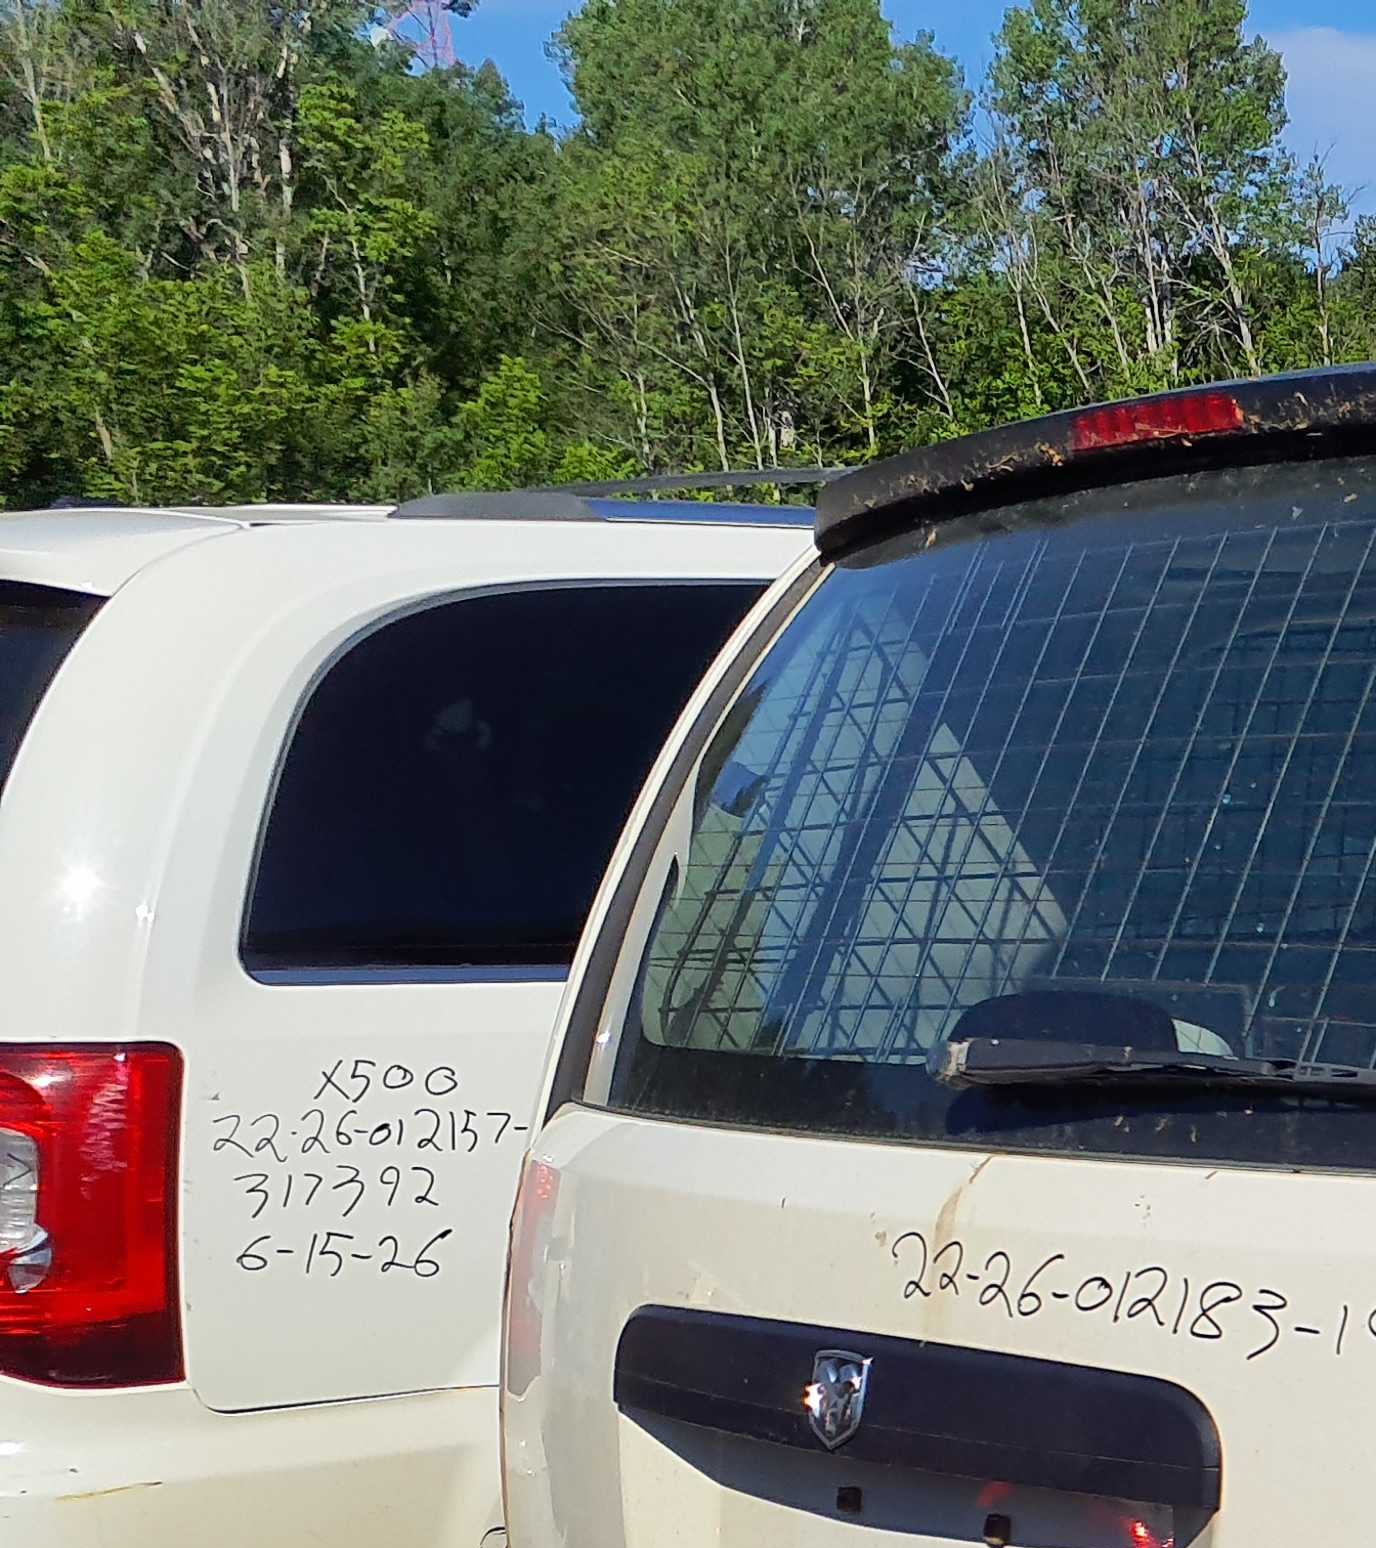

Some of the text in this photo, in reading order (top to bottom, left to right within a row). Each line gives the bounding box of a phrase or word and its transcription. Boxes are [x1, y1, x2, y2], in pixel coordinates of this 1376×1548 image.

[313, 1059, 459, 1103] X500
[233, 1165, 439, 1218] 317392
[236, 1228, 453, 1277] 6-15-26
